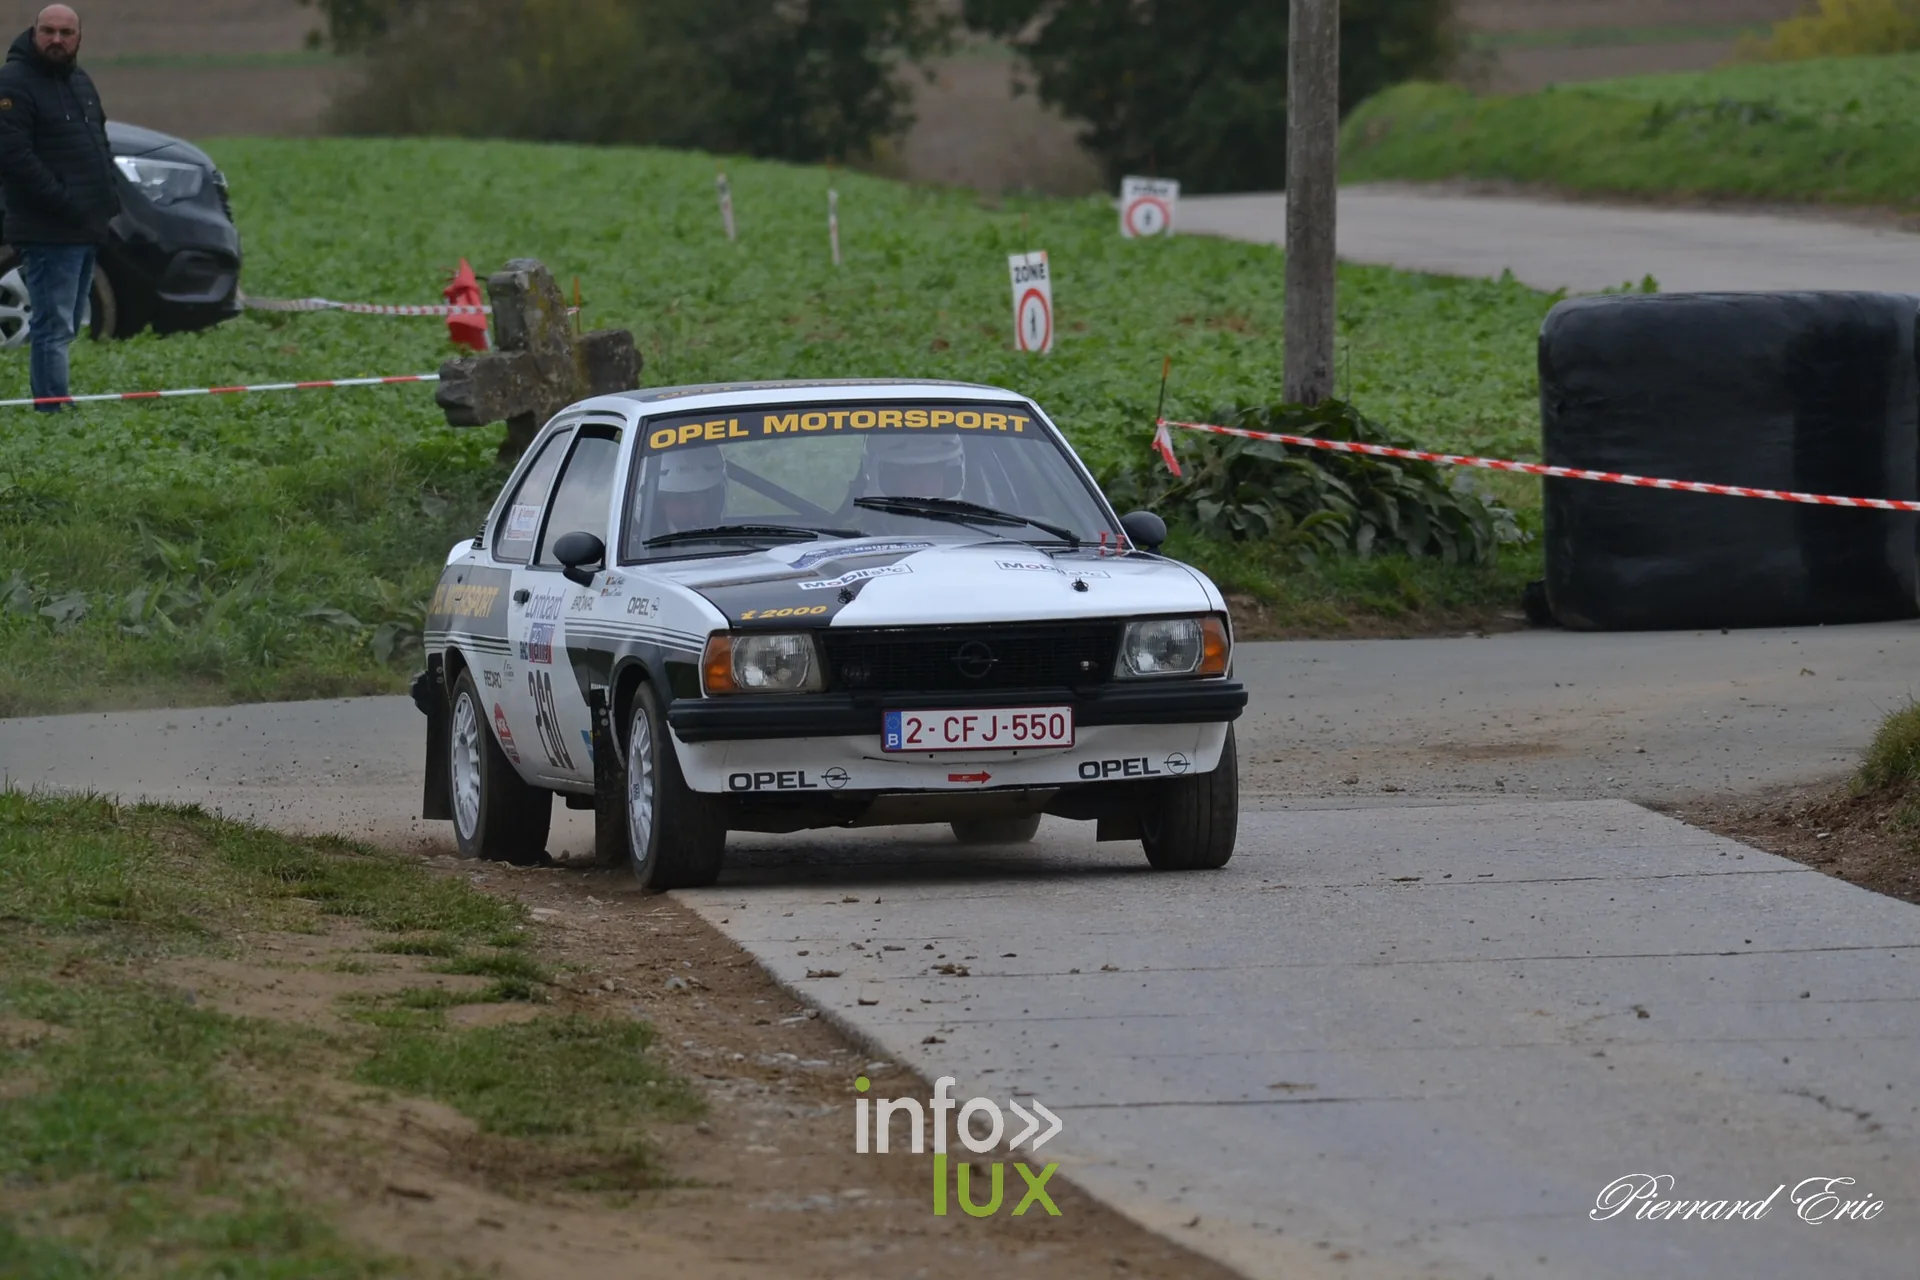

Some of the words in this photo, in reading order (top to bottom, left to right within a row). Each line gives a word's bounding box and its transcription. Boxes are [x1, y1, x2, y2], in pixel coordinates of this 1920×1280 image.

[1014, 263, 1046, 284] ZONE
[649, 418, 749, 450] OPEL
[763, 409, 1030, 434] MOTORSPORT
[803, 571, 868, 589] Mobil
[524, 585, 568, 620] Lombard
[626, 596, 650, 616] OPEL
[758, 605, 828, 619] 2000
[887, 733, 899, 747] B
[1078, 757, 1161, 780] OPEL
[728, 770, 818, 792] OPEL
